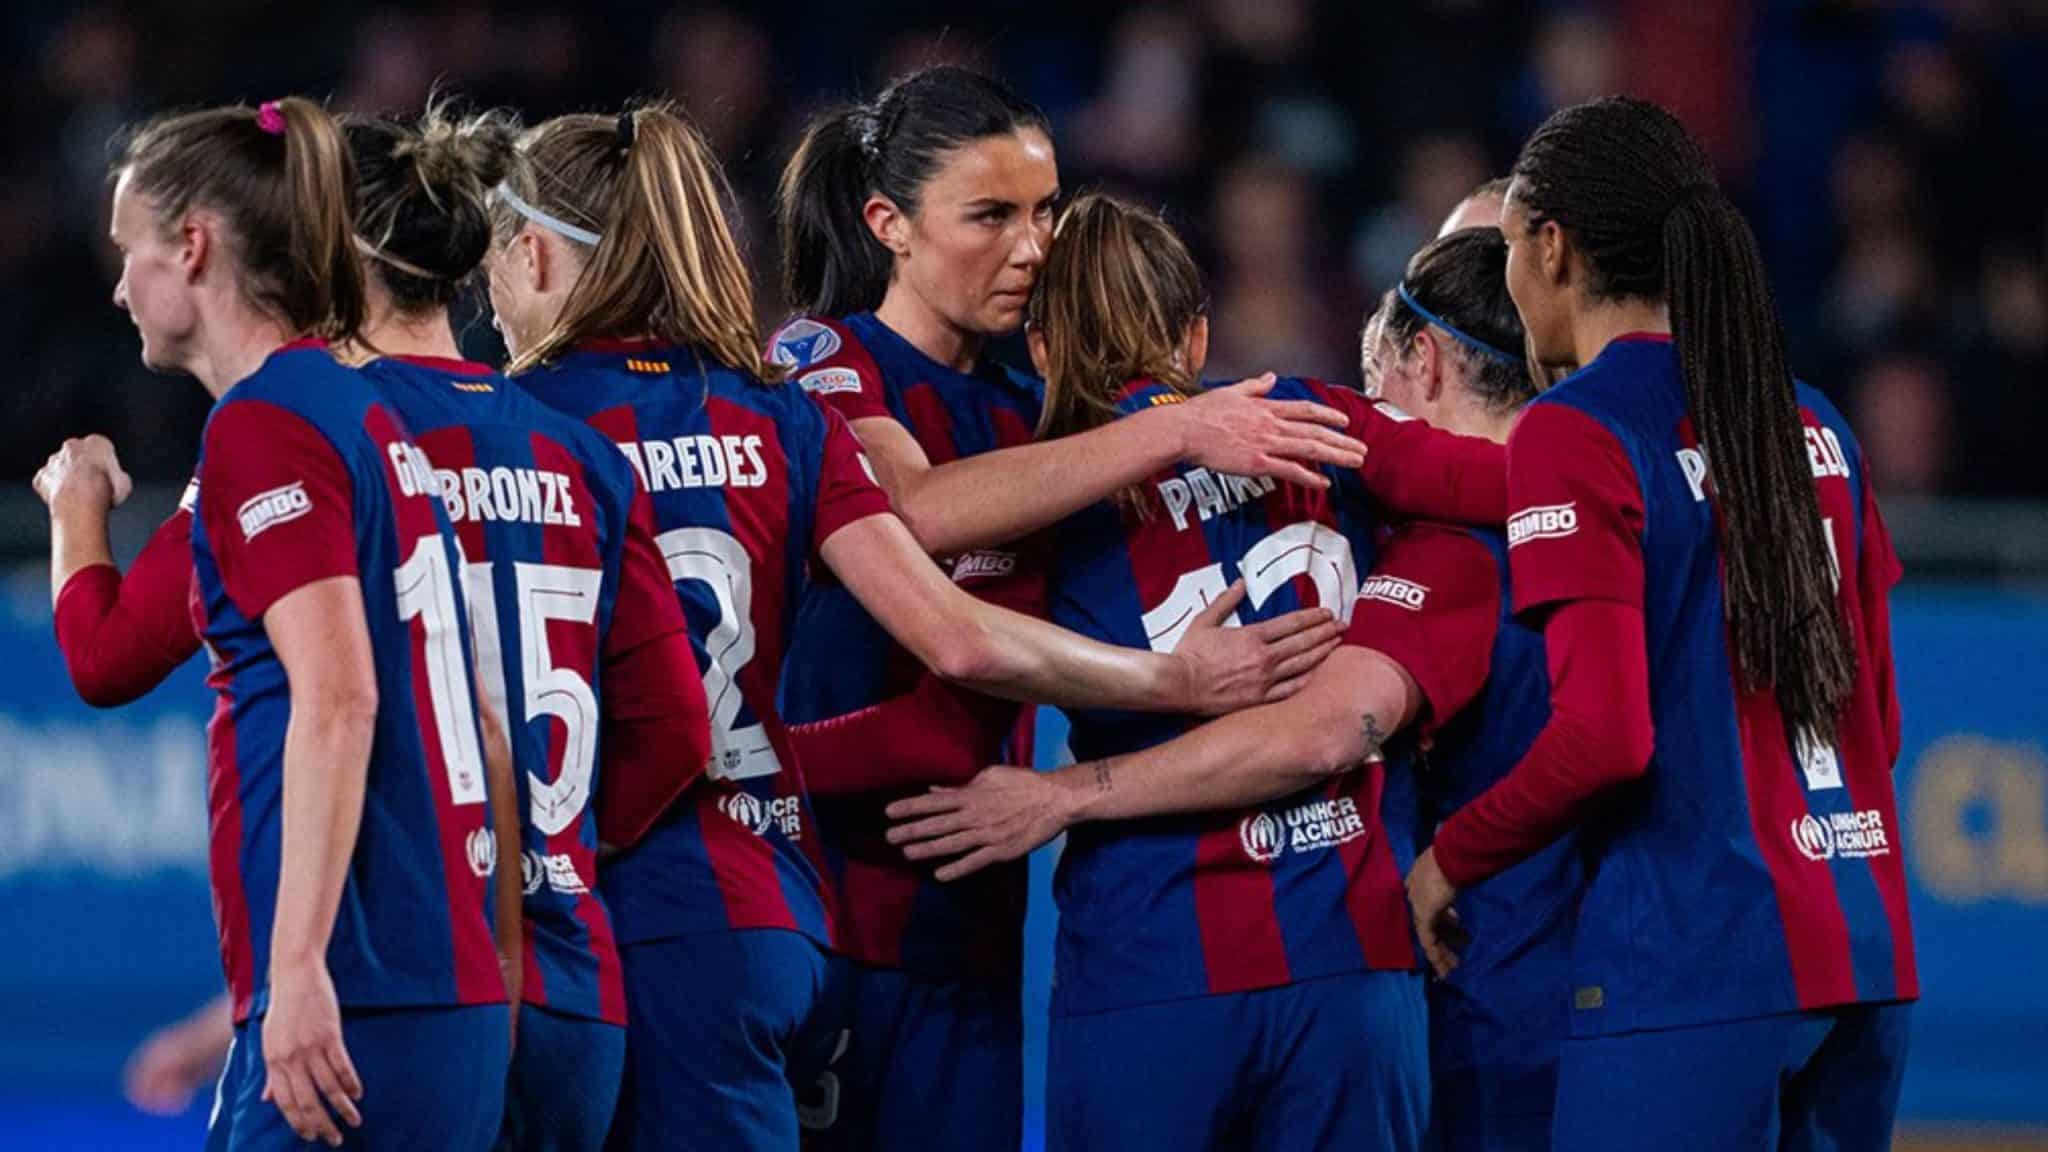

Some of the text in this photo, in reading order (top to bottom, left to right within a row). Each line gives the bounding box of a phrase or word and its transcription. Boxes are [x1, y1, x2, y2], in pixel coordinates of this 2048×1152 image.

[434, 466, 582, 527] BRONZE
[1508, 508, 1577, 542] BIMBO
[394, 533, 488, 806] 1
[1285, 796, 1358, 827] UNHCR
[1829, 809, 1883, 831] UNHCR
[1291, 812, 1364, 846] ACNUR
